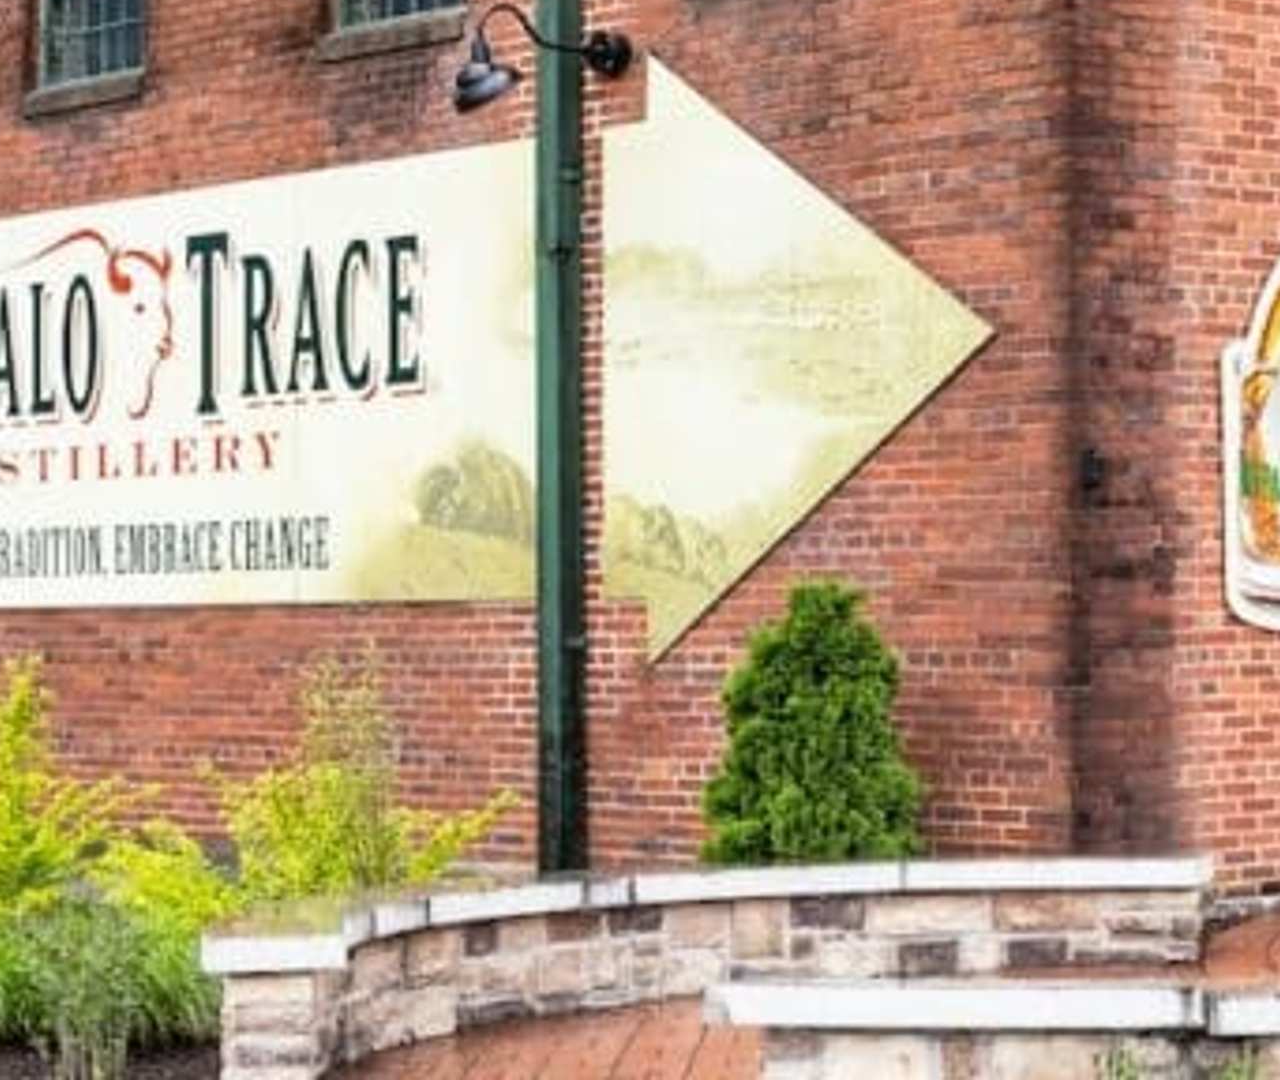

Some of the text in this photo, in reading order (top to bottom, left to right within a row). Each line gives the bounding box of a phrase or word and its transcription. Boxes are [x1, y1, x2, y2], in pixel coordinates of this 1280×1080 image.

[185, 231, 422, 417] TRACE
[114, 521, 221, 575] EMBRACE
[229, 516, 330, 571] CHANGE
